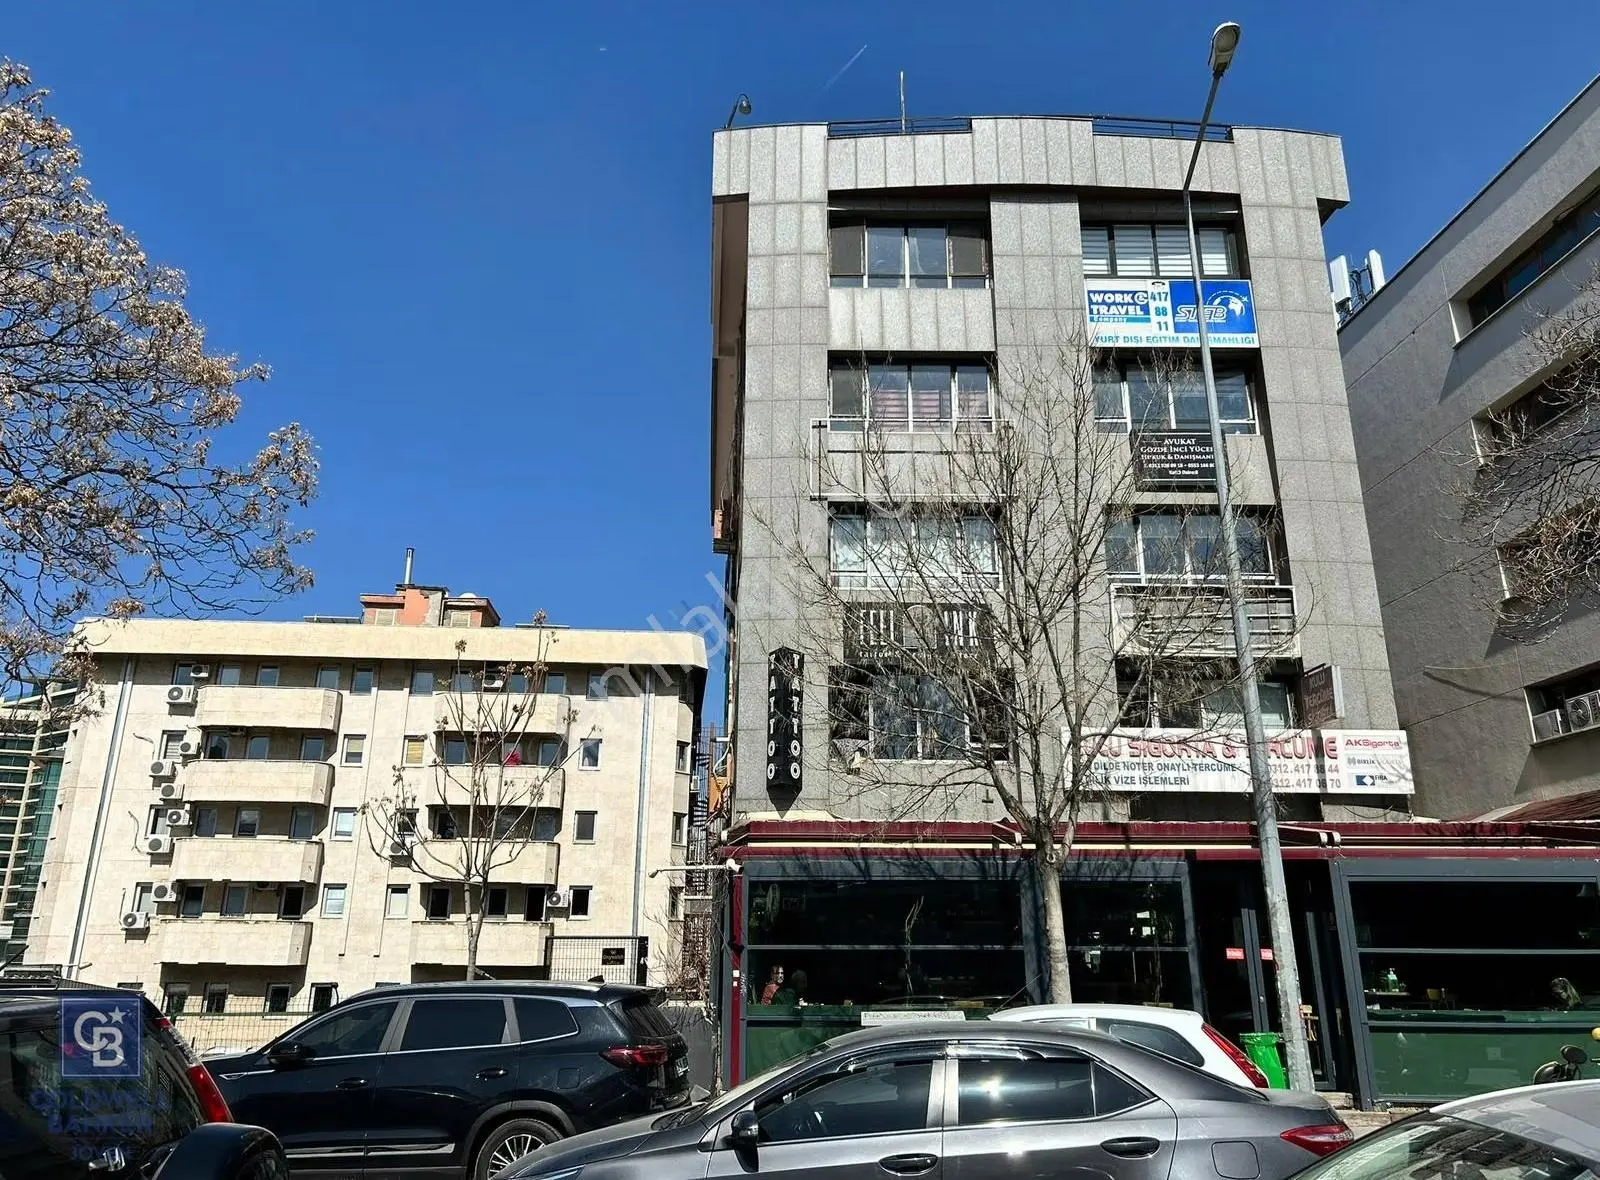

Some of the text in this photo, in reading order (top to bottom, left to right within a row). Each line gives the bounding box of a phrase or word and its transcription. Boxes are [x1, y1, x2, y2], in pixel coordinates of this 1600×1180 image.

[1089, 292, 1134, 304] WORK
[1150, 291, 1169, 302] 417
[1090, 304, 1145, 315] TRAVEL
[1154, 306, 1169, 317] 88
[1156, 321, 1169, 332] 11
[1095, 335, 1120, 344] YURT
[790, 653, 801, 780] TATTOO
[1345, 738, 1401, 748] AKSigorta
[1123, 761, 1155, 772] NOTER
[1327, 764, 1340, 774] 44
[1114, 774, 1137, 786] VİZE
[1138, 775, 1190, 787] İŞLEMLERİ
[1329, 778, 1342, 789] 70
